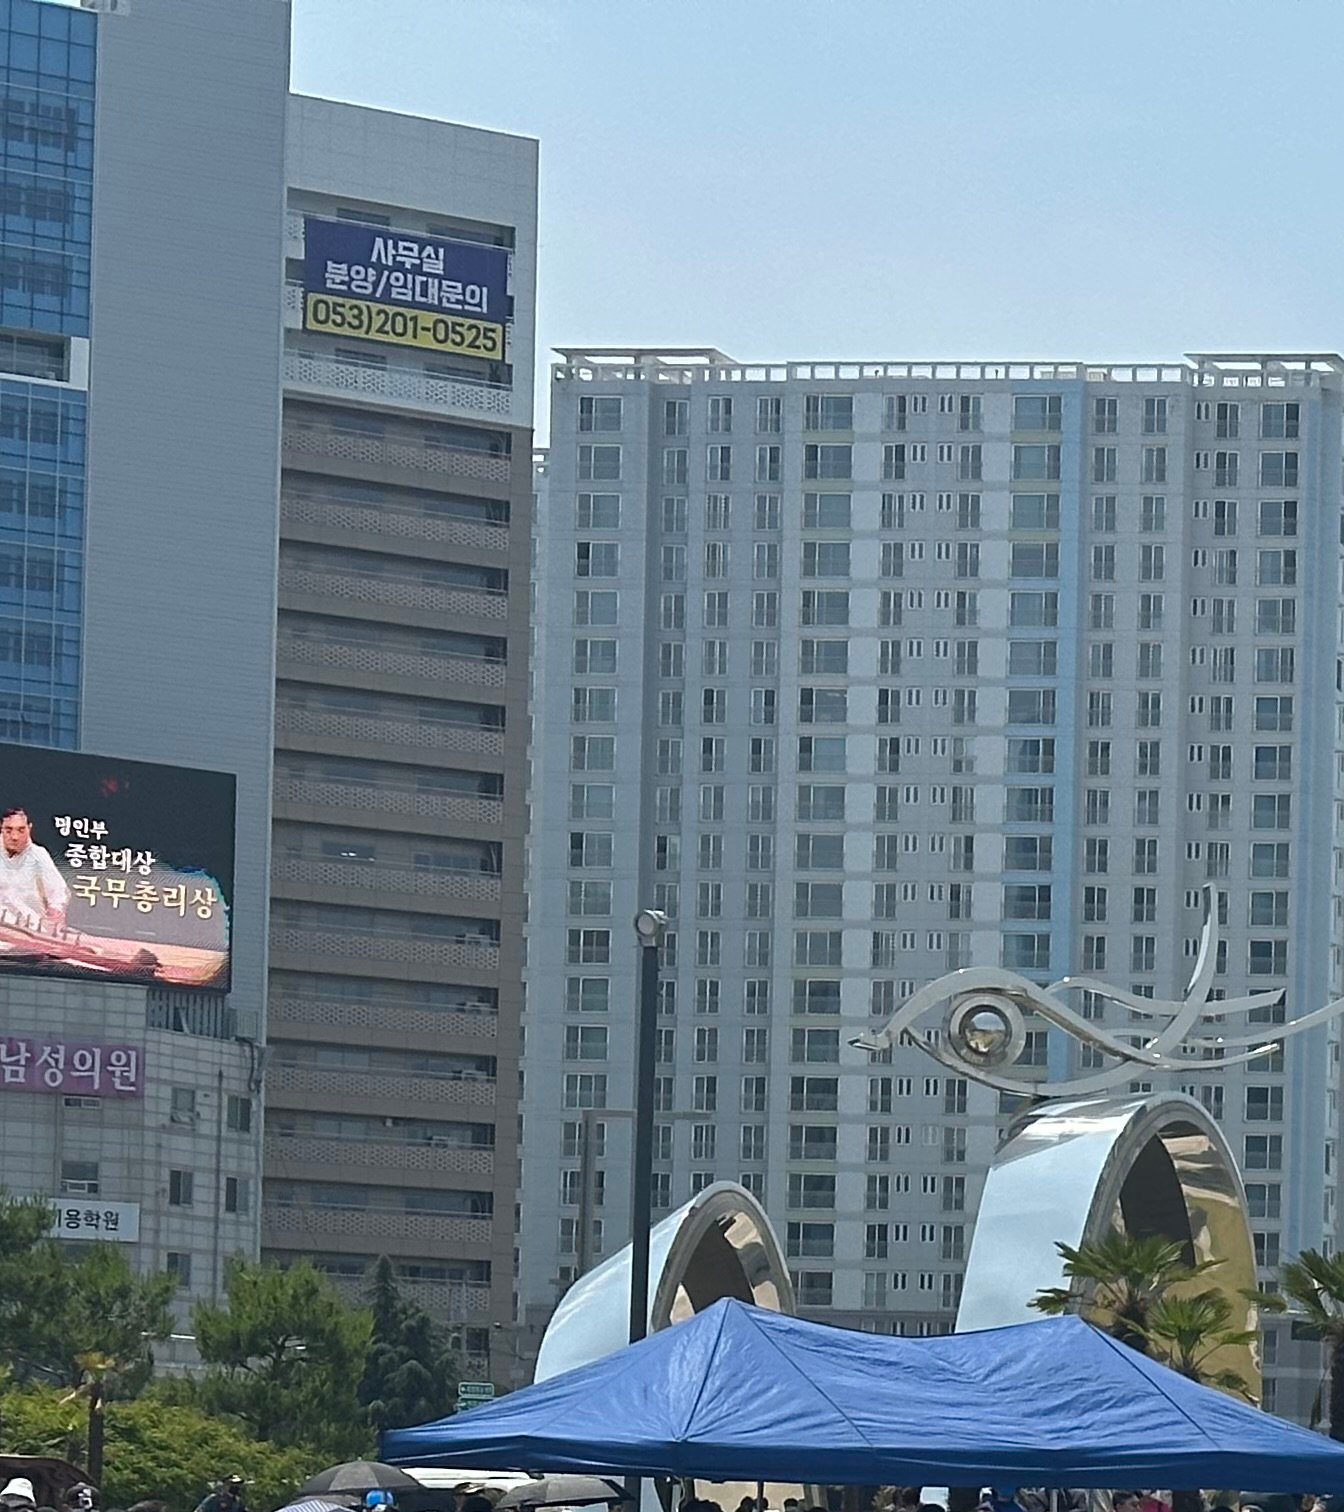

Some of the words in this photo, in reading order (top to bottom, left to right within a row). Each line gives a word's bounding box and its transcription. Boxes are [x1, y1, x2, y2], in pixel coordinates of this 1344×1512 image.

[371, 237, 444, 275] 사무실
[324, 260, 488, 314] 분양/임대문의
[312, 299, 498, 352] 053)201-0525
[55, 816, 109, 840] 명인부
[65, 843, 156, 875] 종합대상
[72, 875, 218, 919] 국무총리상
[0, 1042, 137, 1091] 남성의원
